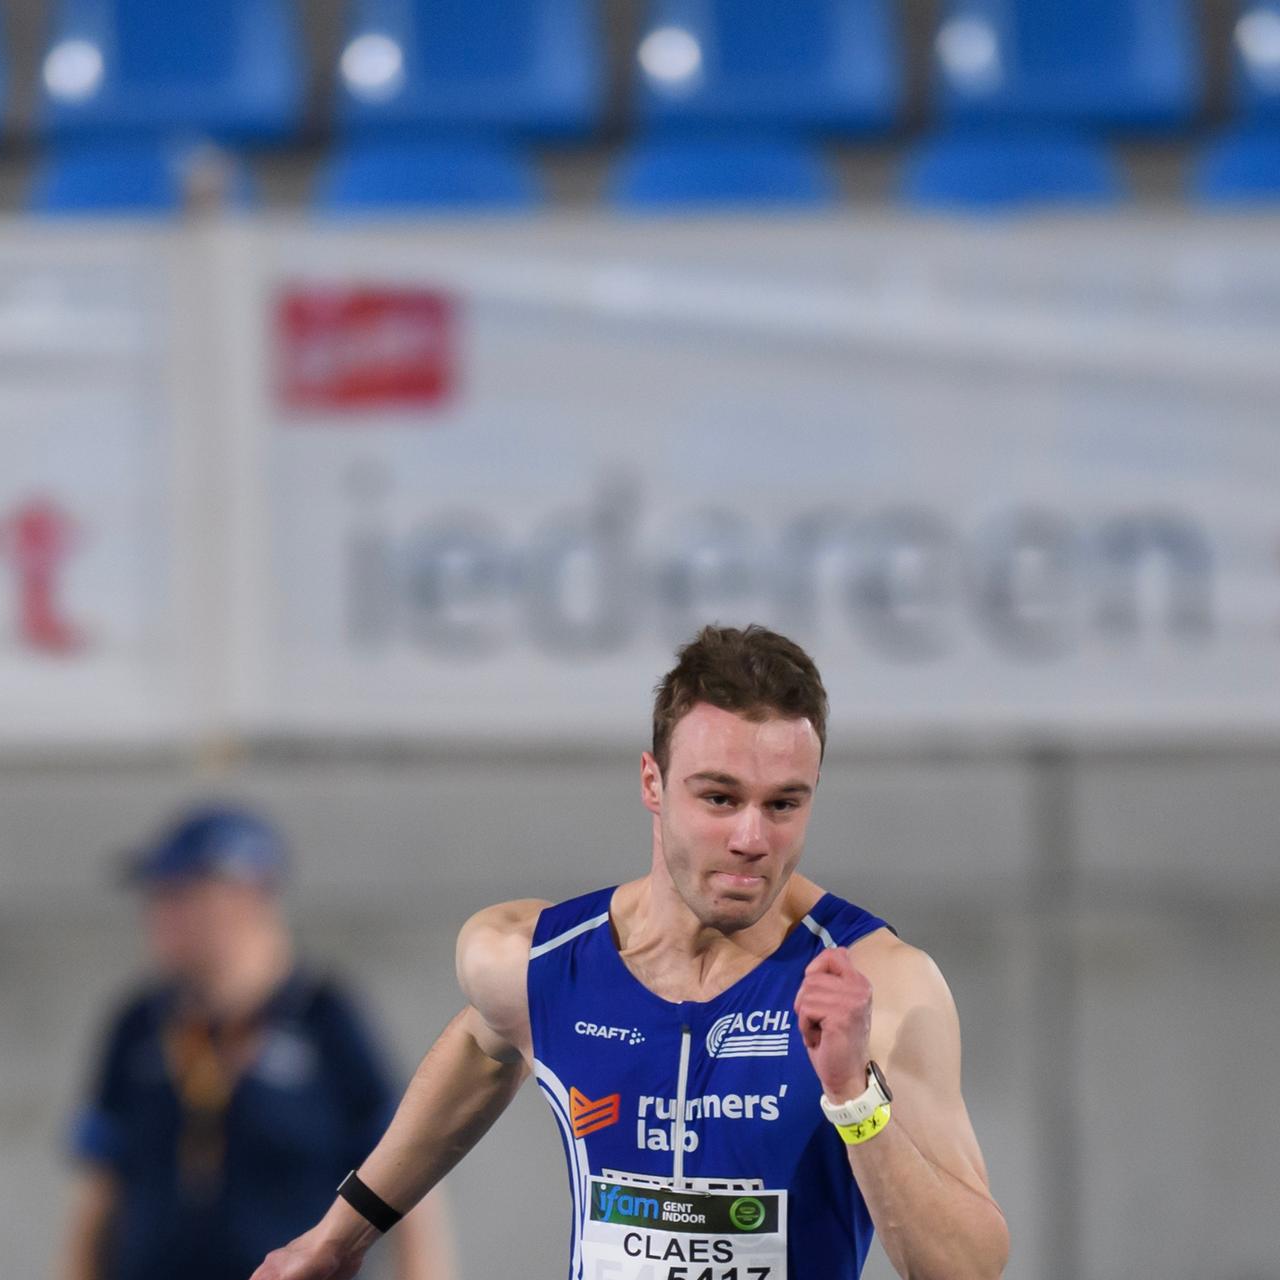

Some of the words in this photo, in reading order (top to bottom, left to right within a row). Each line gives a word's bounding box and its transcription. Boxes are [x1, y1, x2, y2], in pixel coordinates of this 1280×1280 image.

[575, 1021, 630, 1042] CRAFT
[637, 1119, 699, 1153] lab
[599, 1184, 660, 1222] ifam
[663, 1201, 693, 1213] GENT
[662, 1213, 705, 1224] INDOOR
[624, 1232, 733, 1263] CLAES
